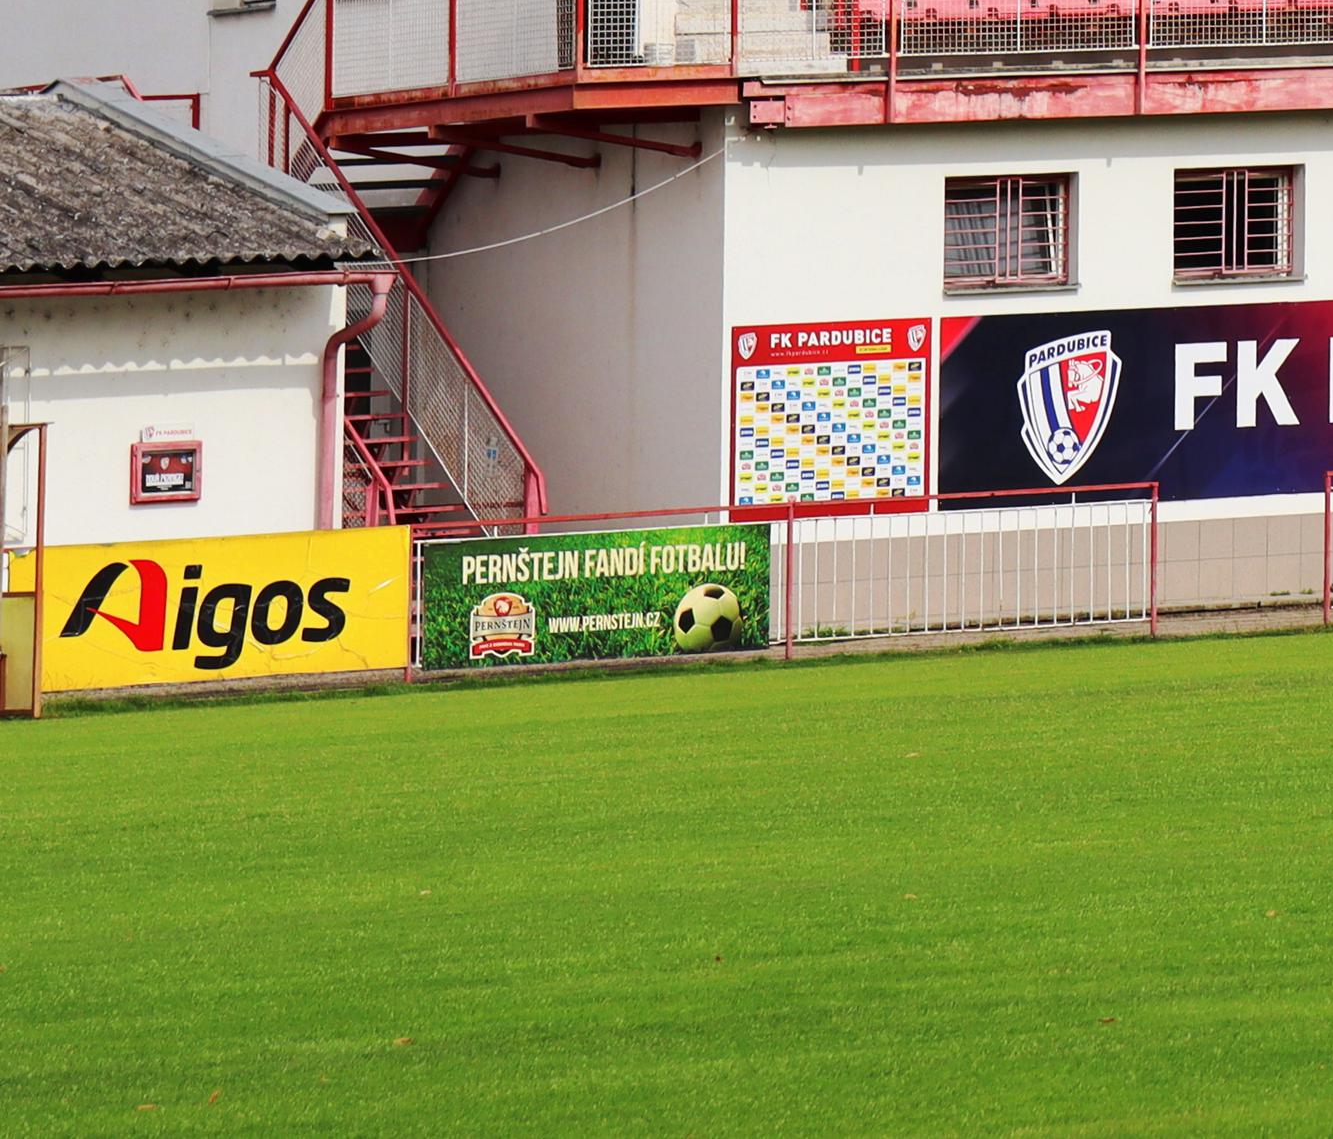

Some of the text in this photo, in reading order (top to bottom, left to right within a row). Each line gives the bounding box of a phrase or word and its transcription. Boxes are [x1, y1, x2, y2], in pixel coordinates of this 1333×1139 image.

[770, 328, 892, 348] FK PARDUBICE
[1029, 335, 1107, 368] PARDUBICE
[1174, 338, 1300, 431] FK
[462, 540, 746, 585] PERNŠTEJN FANDÍ FOTBALU!
[474, 618, 531, 632] PERNŠTEJN
[548, 611, 661, 634] WWW.PERNSTEJN.CZ
